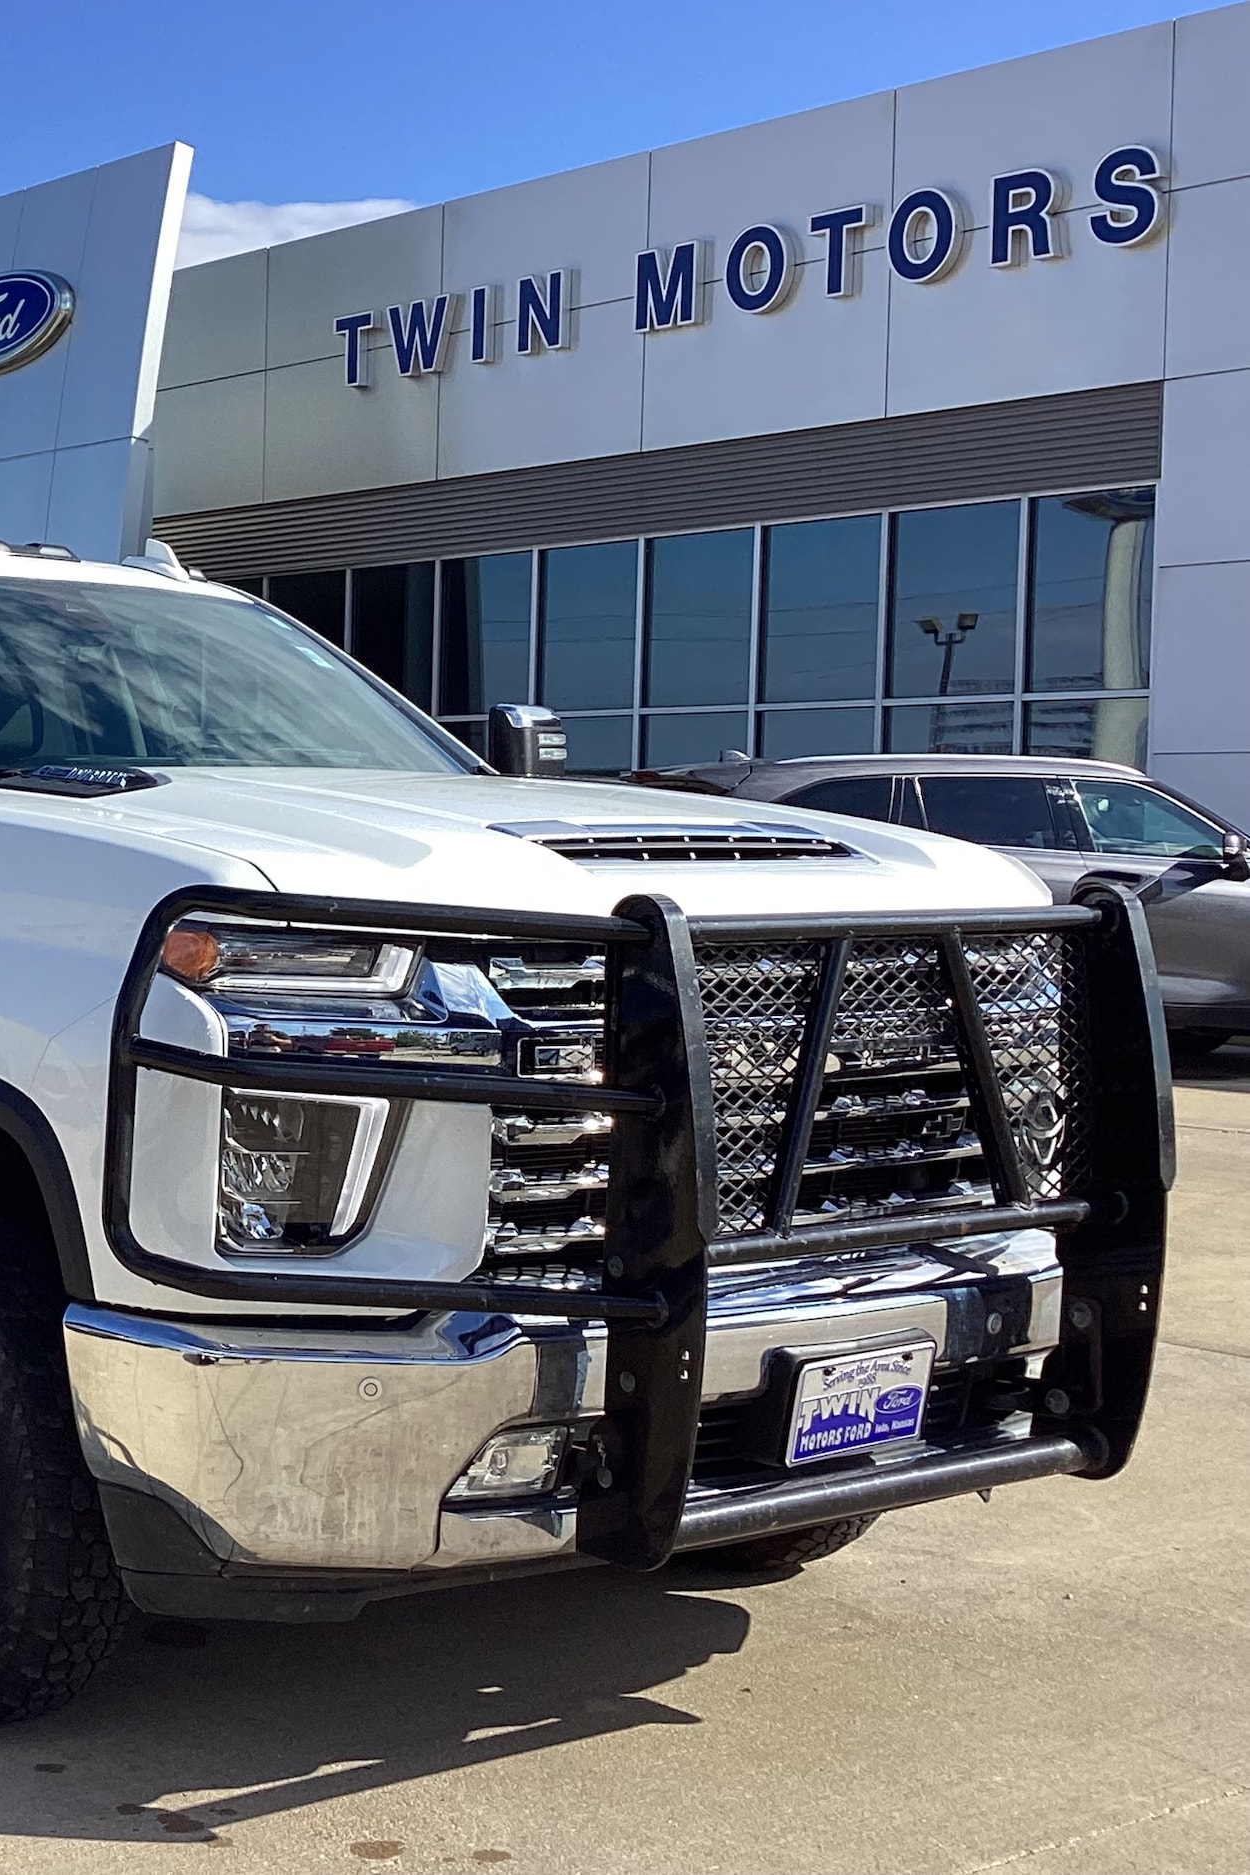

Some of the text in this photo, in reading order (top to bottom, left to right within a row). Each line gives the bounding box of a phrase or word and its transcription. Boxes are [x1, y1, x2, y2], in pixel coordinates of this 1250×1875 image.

[334, 143, 1166, 388] TWIN MOTORS
[823, 1359, 911, 1391] Serving the Area Since
[800, 1387, 881, 1432] TWIN
[882, 1389, 915, 1410] Ford
[800, 1422, 872, 1453] MOTORS FORD
